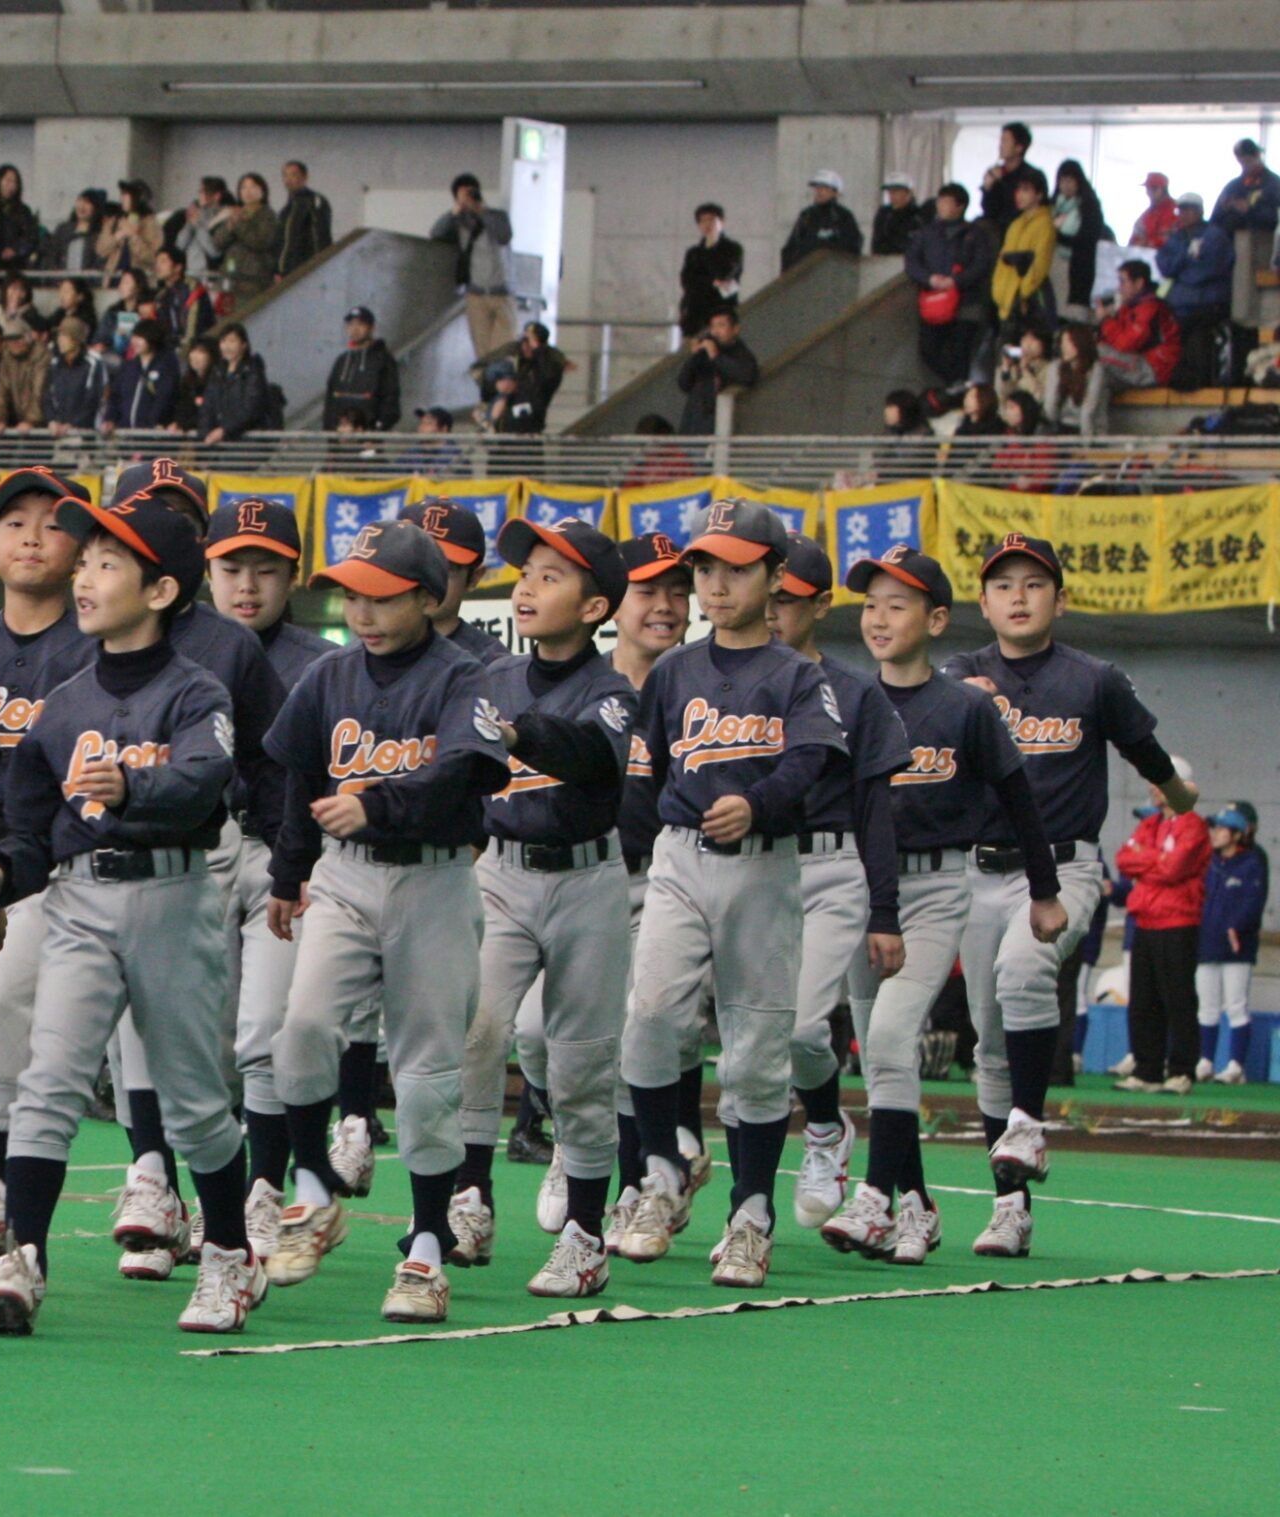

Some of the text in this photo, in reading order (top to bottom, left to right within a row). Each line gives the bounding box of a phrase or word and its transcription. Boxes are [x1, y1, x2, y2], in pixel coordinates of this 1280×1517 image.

[238, 501, 269, 533] L
[422, 506, 449, 539] L
[704, 501, 735, 532] L
[846, 504, 913, 544] 交通
[347, 526, 383, 559] L
[1170, 531, 1265, 571] 交通安全
[670, 697, 784, 774] Lions
